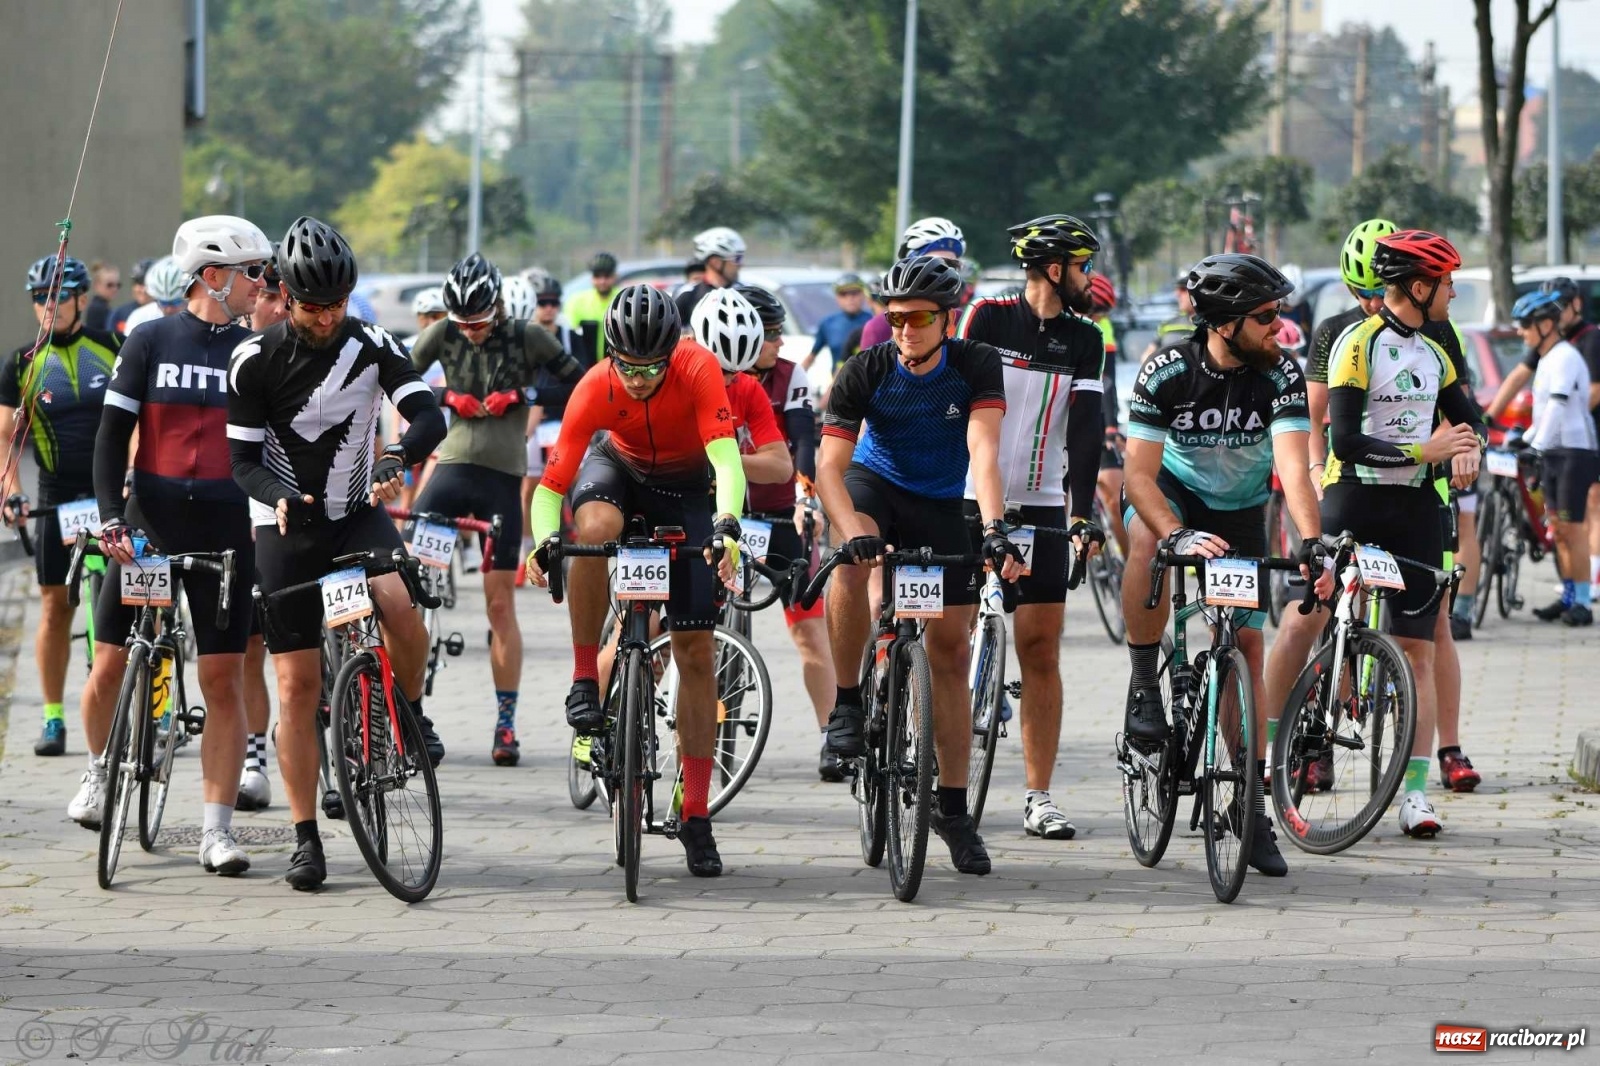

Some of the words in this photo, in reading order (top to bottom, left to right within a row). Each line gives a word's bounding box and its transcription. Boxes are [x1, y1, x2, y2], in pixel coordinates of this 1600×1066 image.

[994, 346, 1033, 361] OGELLI
[1138, 349, 1183, 386] BORA
[1201, 361, 1225, 380] BORA
[1277, 355, 1299, 385] ORA
[1170, 407, 1265, 431] BORA
[1364, 453, 1406, 463] MERIDA
[64, 511, 98, 528] 1476
[416, 535, 452, 554] 1516
[739, 532, 767, 549] 469
[621, 565, 667, 581] 1466
[1361, 559, 1398, 575] 1470
[125, 572, 168, 588] 1475
[1210, 573, 1255, 590] 1473
[325, 582, 366, 608] 1474
[899, 583, 941, 599] 1504
